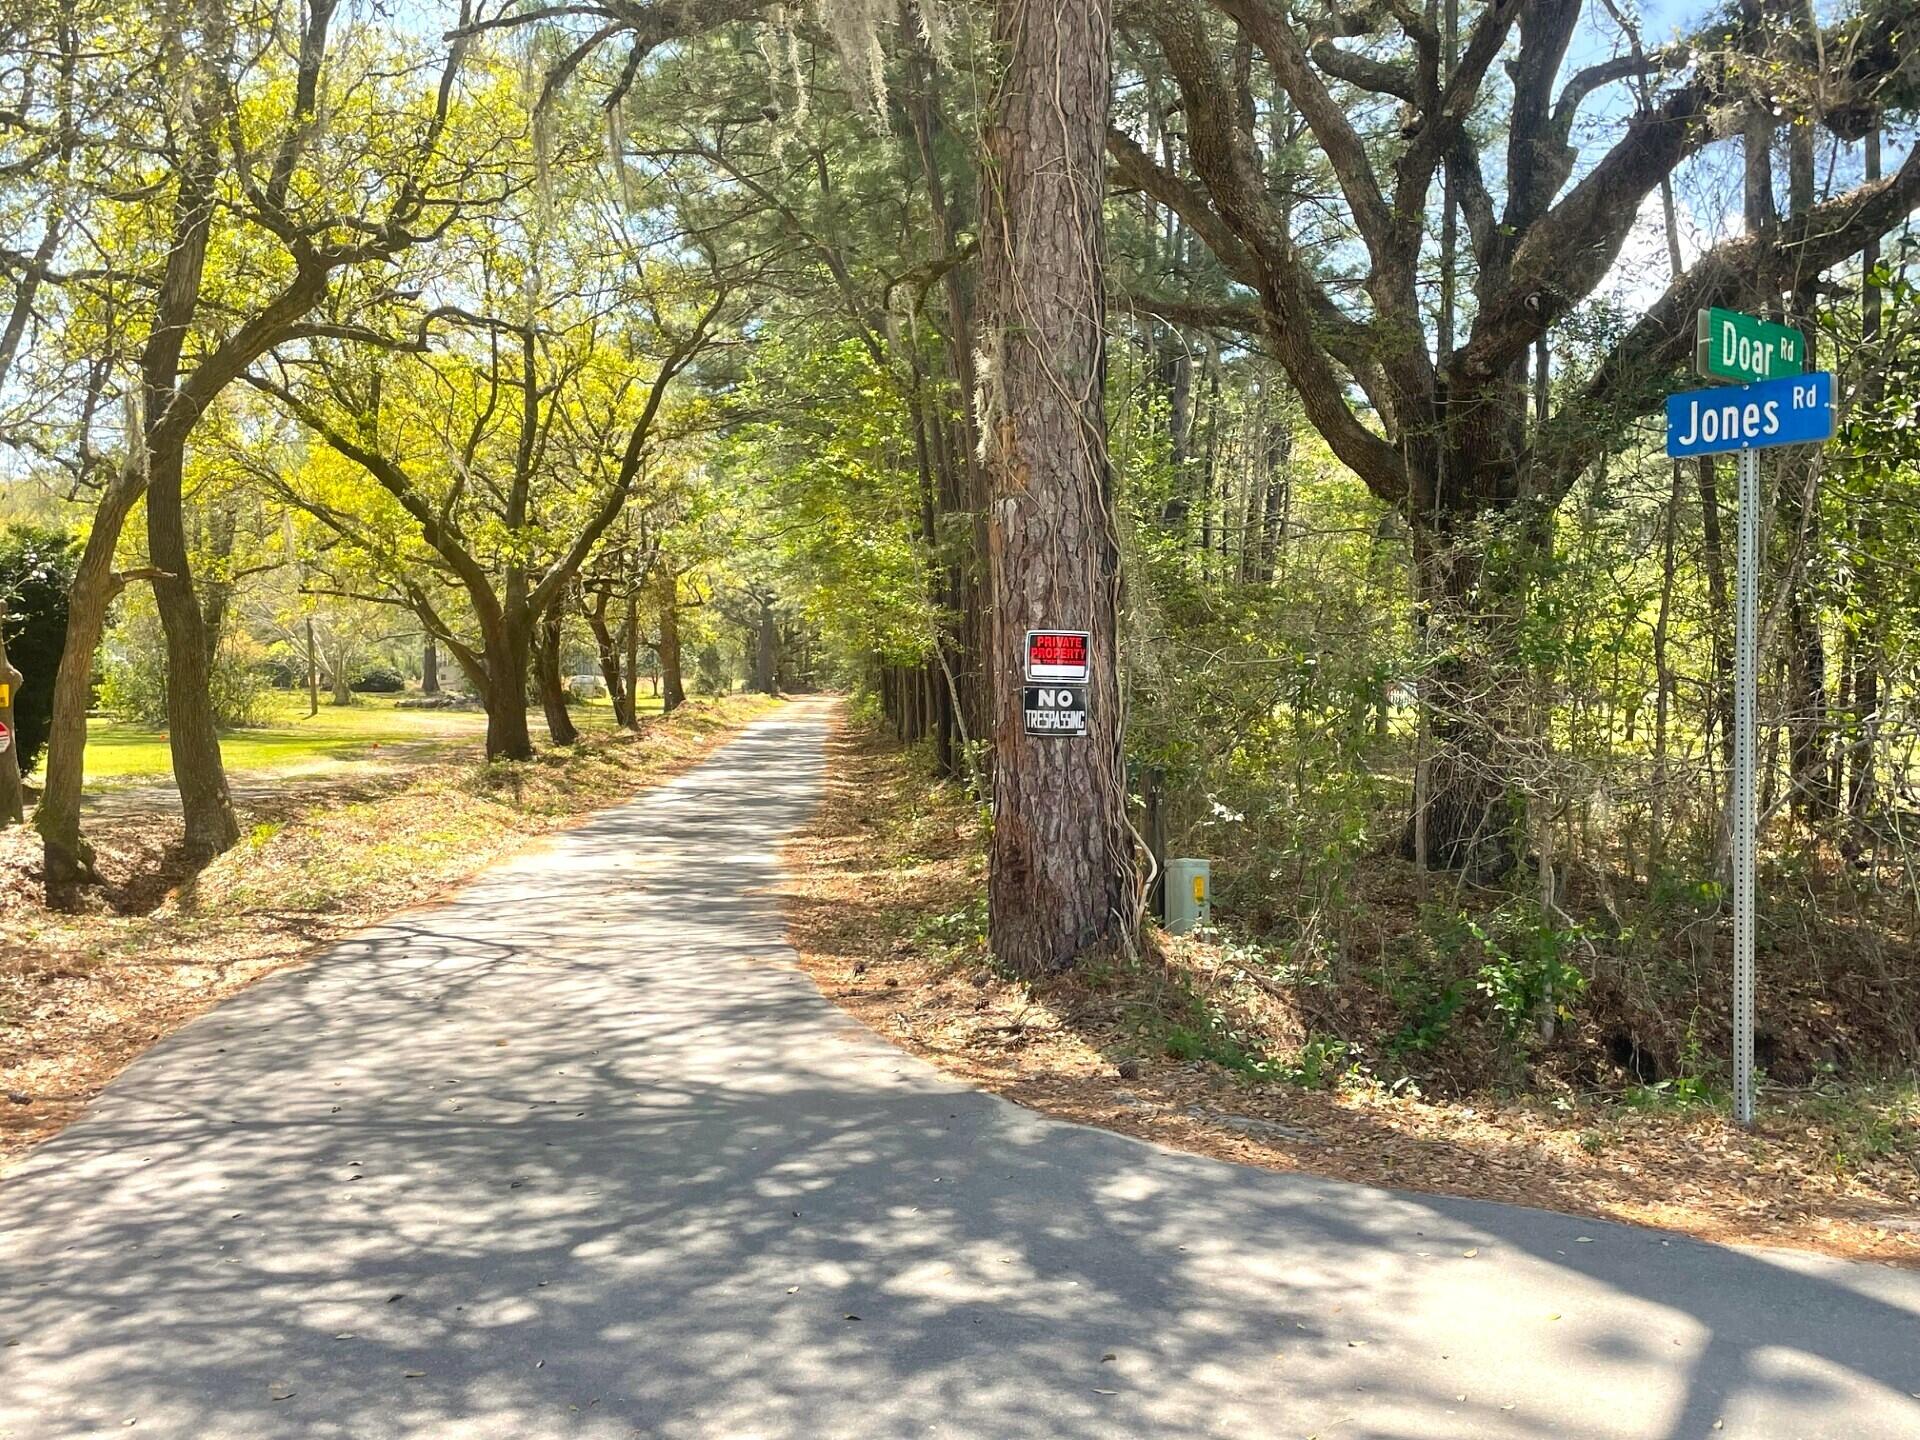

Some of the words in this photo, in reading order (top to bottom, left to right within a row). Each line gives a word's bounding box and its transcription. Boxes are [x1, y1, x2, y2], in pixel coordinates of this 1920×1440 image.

[1722, 320, 1774, 375] Doar
[1780, 337, 1793, 362] Rd
[1678, 400, 1780, 446] Jones
[1792, 384, 1817, 410] Rd
[1037, 636, 1082, 648] PRIVATE
[1031, 648, 1086, 659] PROPERTY
[1037, 689, 1073, 708] NO
[1025, 709, 1085, 729] TRESPASSING
